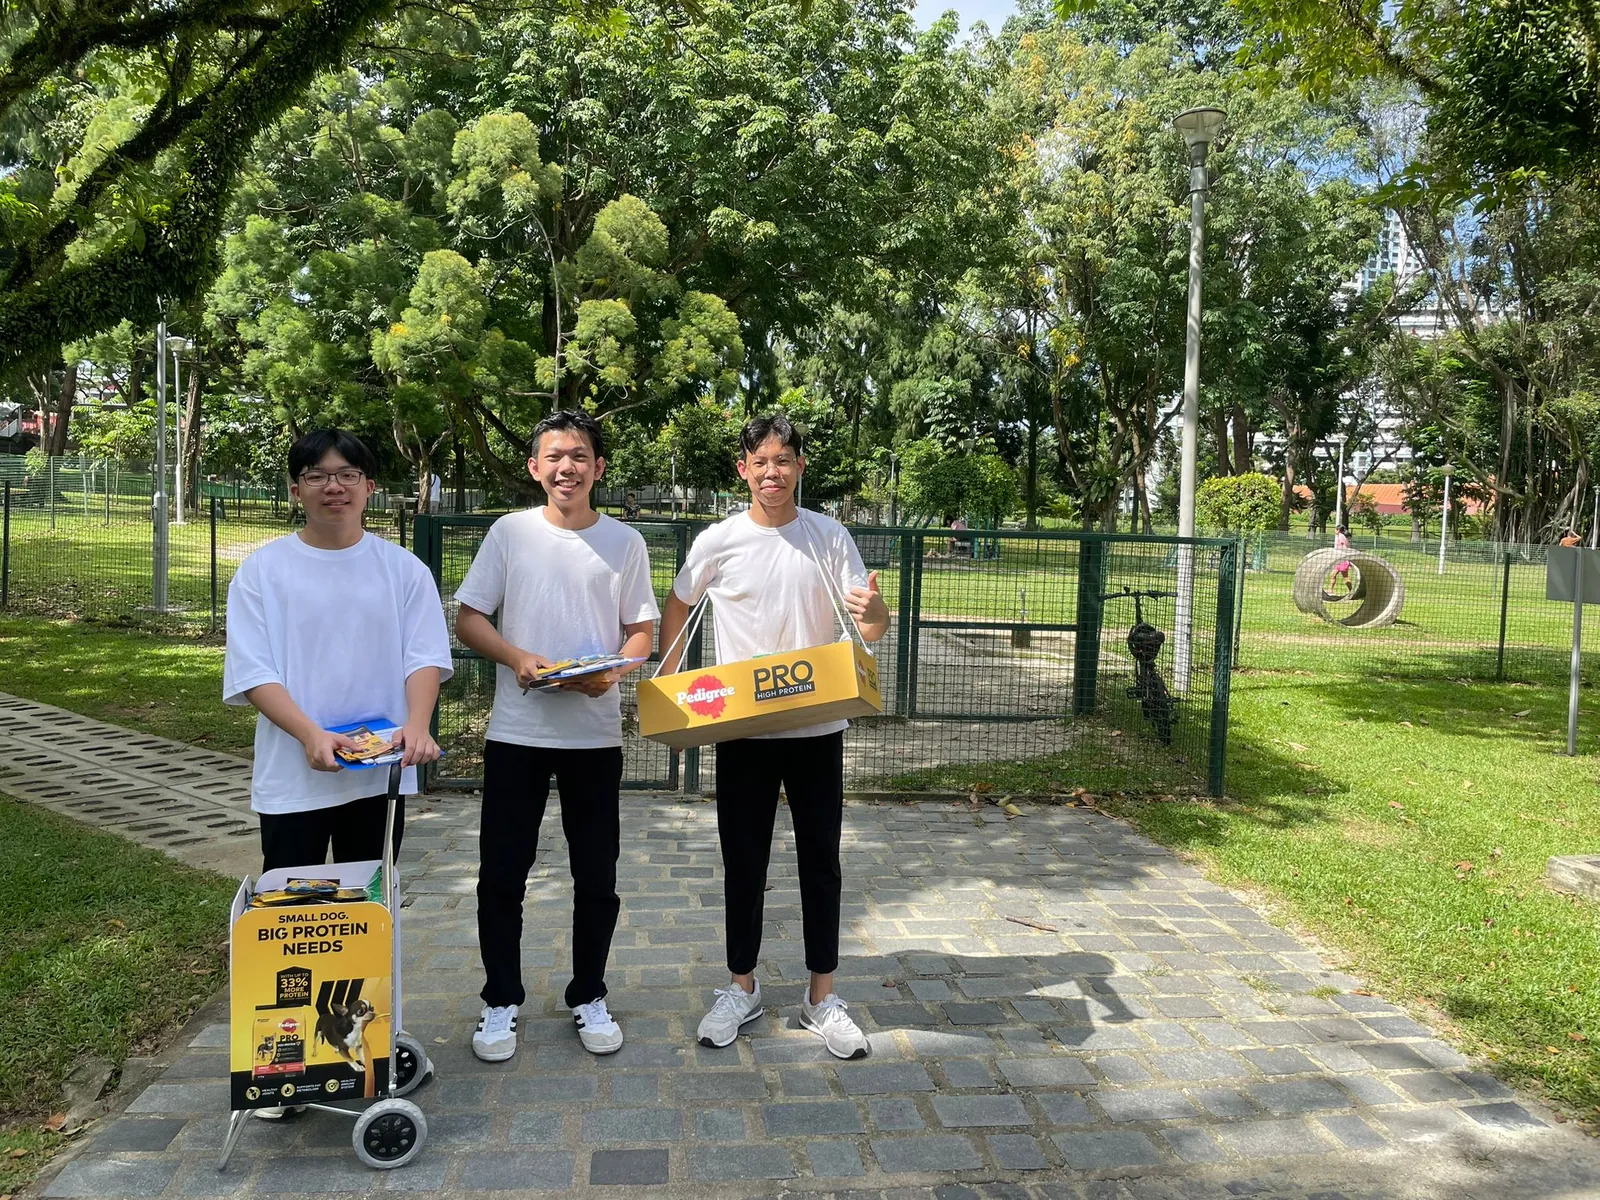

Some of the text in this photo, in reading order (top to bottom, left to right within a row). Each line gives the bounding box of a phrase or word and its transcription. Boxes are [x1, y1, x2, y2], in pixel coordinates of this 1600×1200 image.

[753, 660, 813, 692] PRO
[675, 685, 736, 705] Pedigree
[757, 683, 813, 700] HIGH PROTEIN
[278, 911, 349, 923] SMALL DOG.
[258, 922, 368, 941] BIG PROTEIN
[283, 940, 343, 956] NEEDS
[280, 977, 309, 988] 33%
[279, 991, 309, 999] PROTEIN
[279, 1034, 299, 1042] PRO
